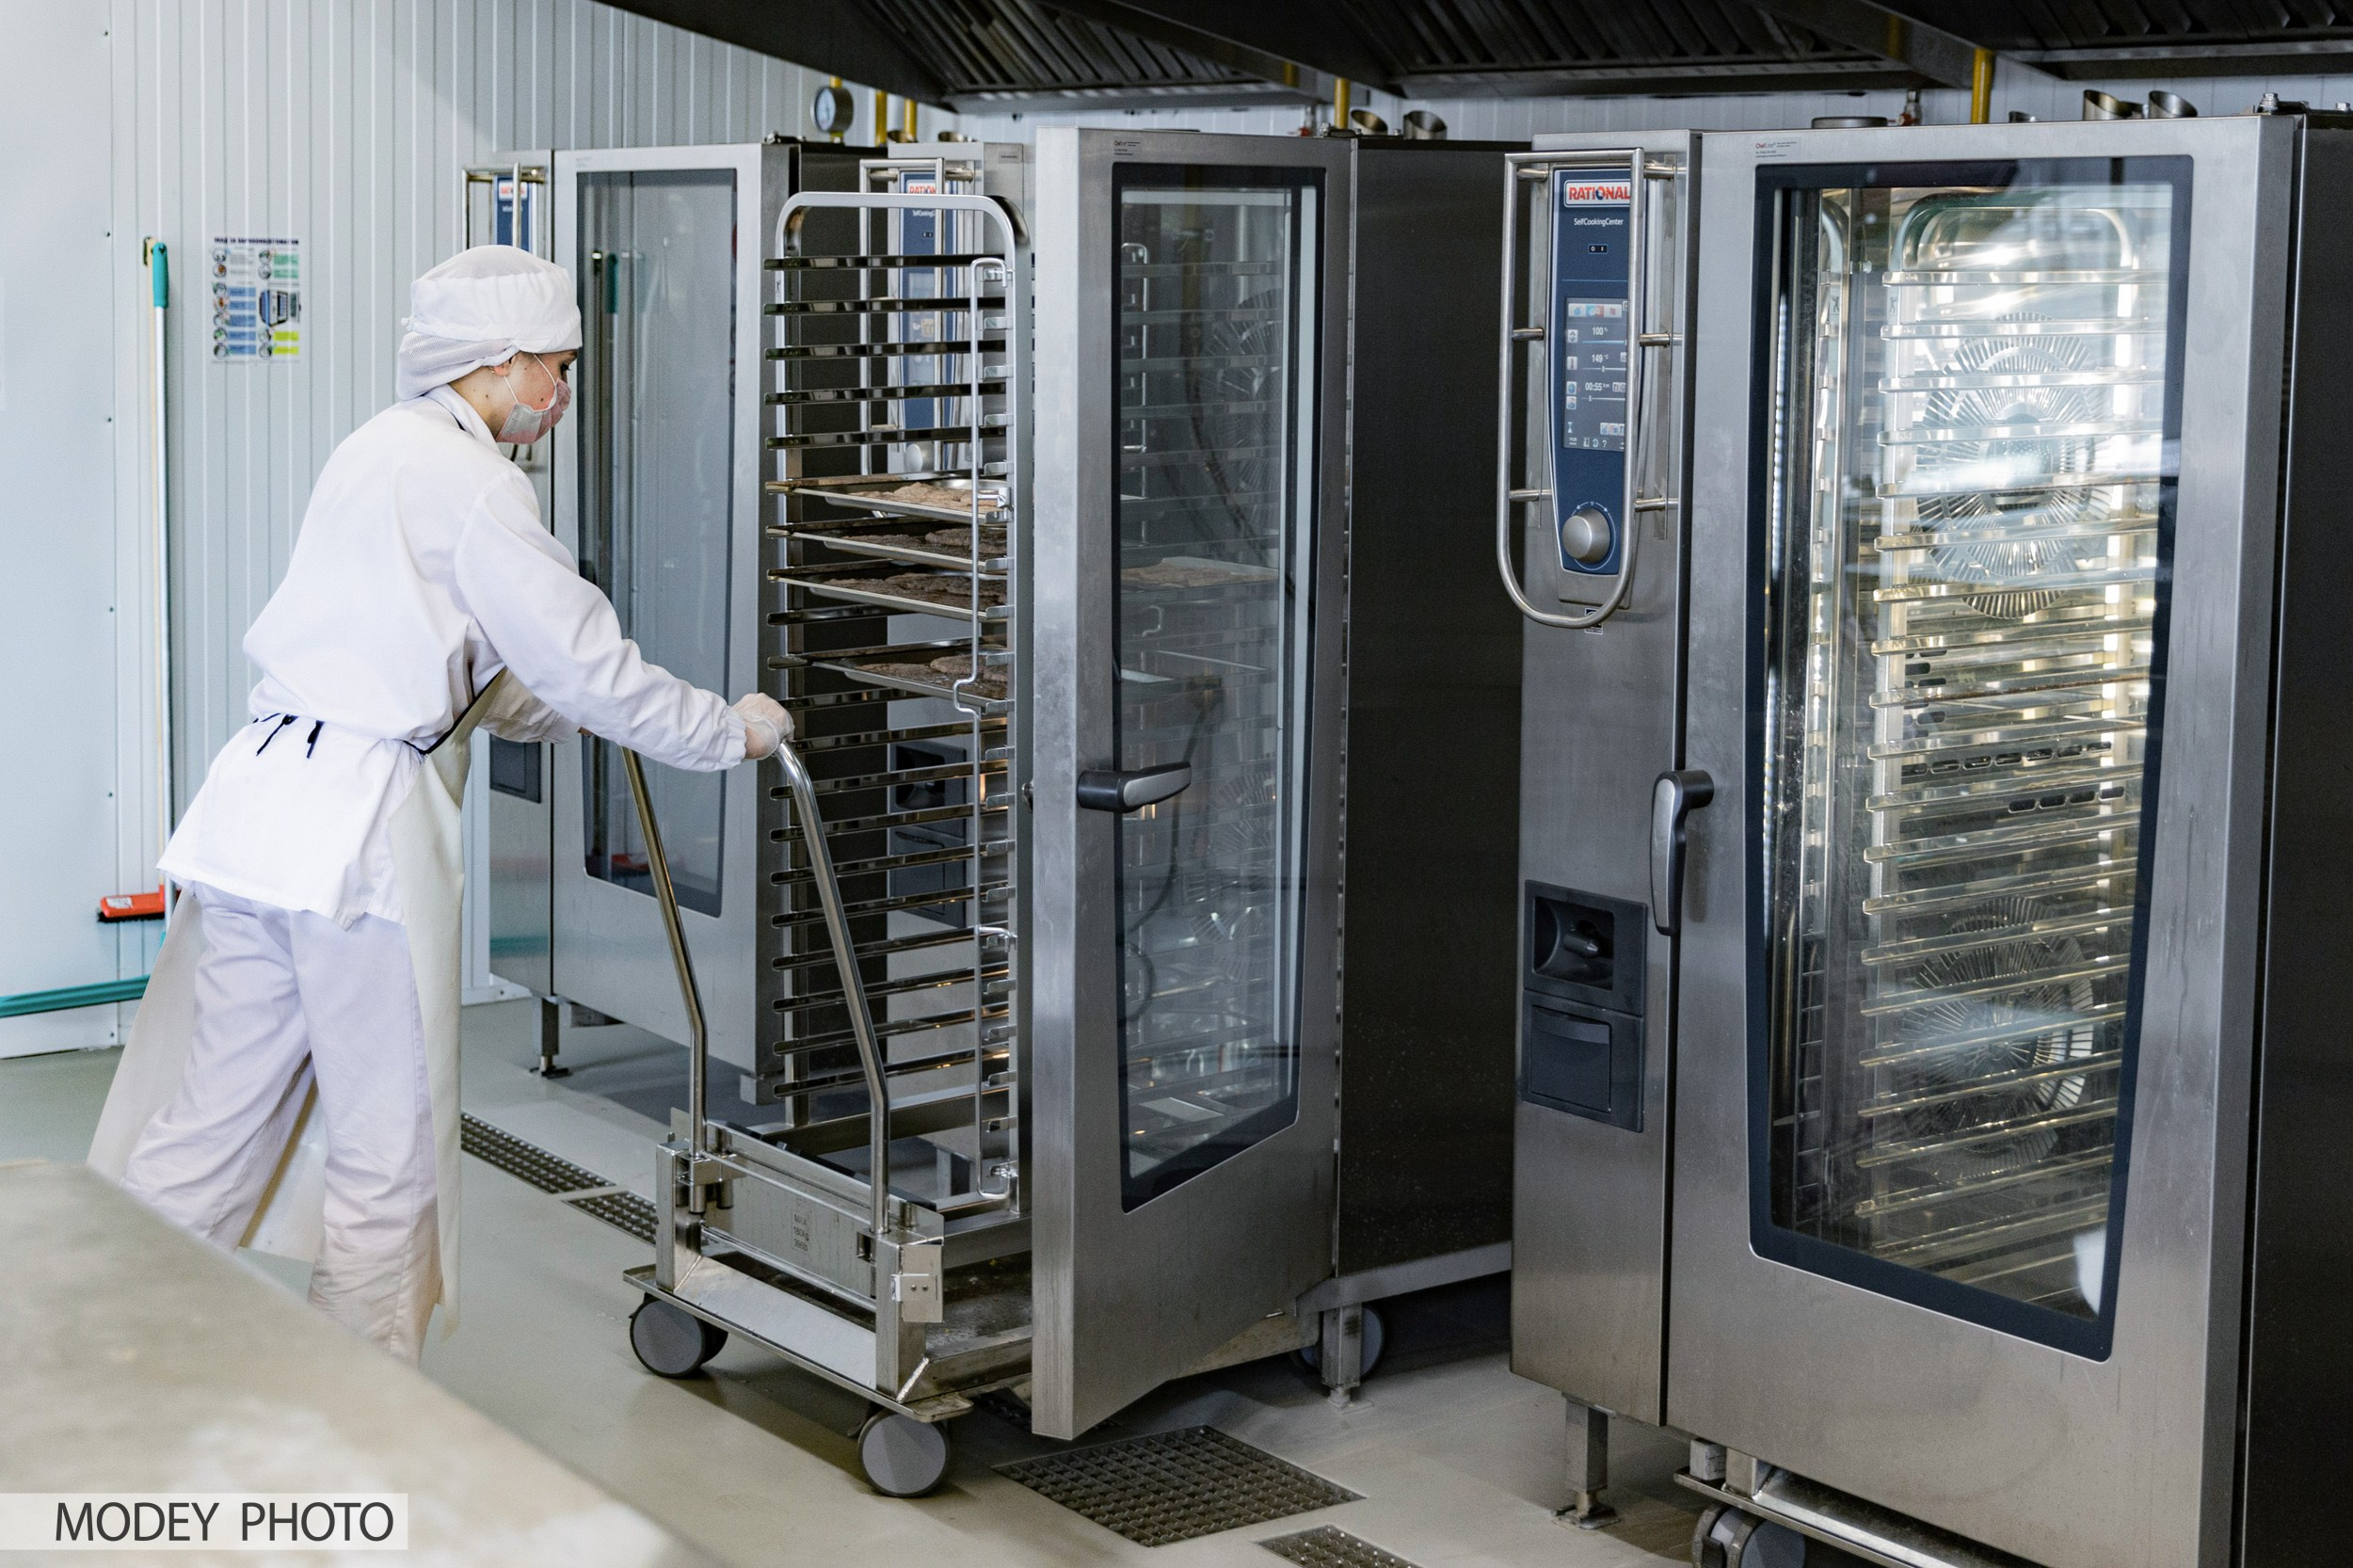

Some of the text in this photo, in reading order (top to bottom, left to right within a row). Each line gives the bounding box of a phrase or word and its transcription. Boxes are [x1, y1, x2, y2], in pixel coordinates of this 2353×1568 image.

[1569, 185, 1631, 200] RATIONAL
[1574, 217, 1624, 227] SelfCookingCenter
[1592, 327, 1604, 335] 100
[1585, 382, 1603, 392] 00:55
